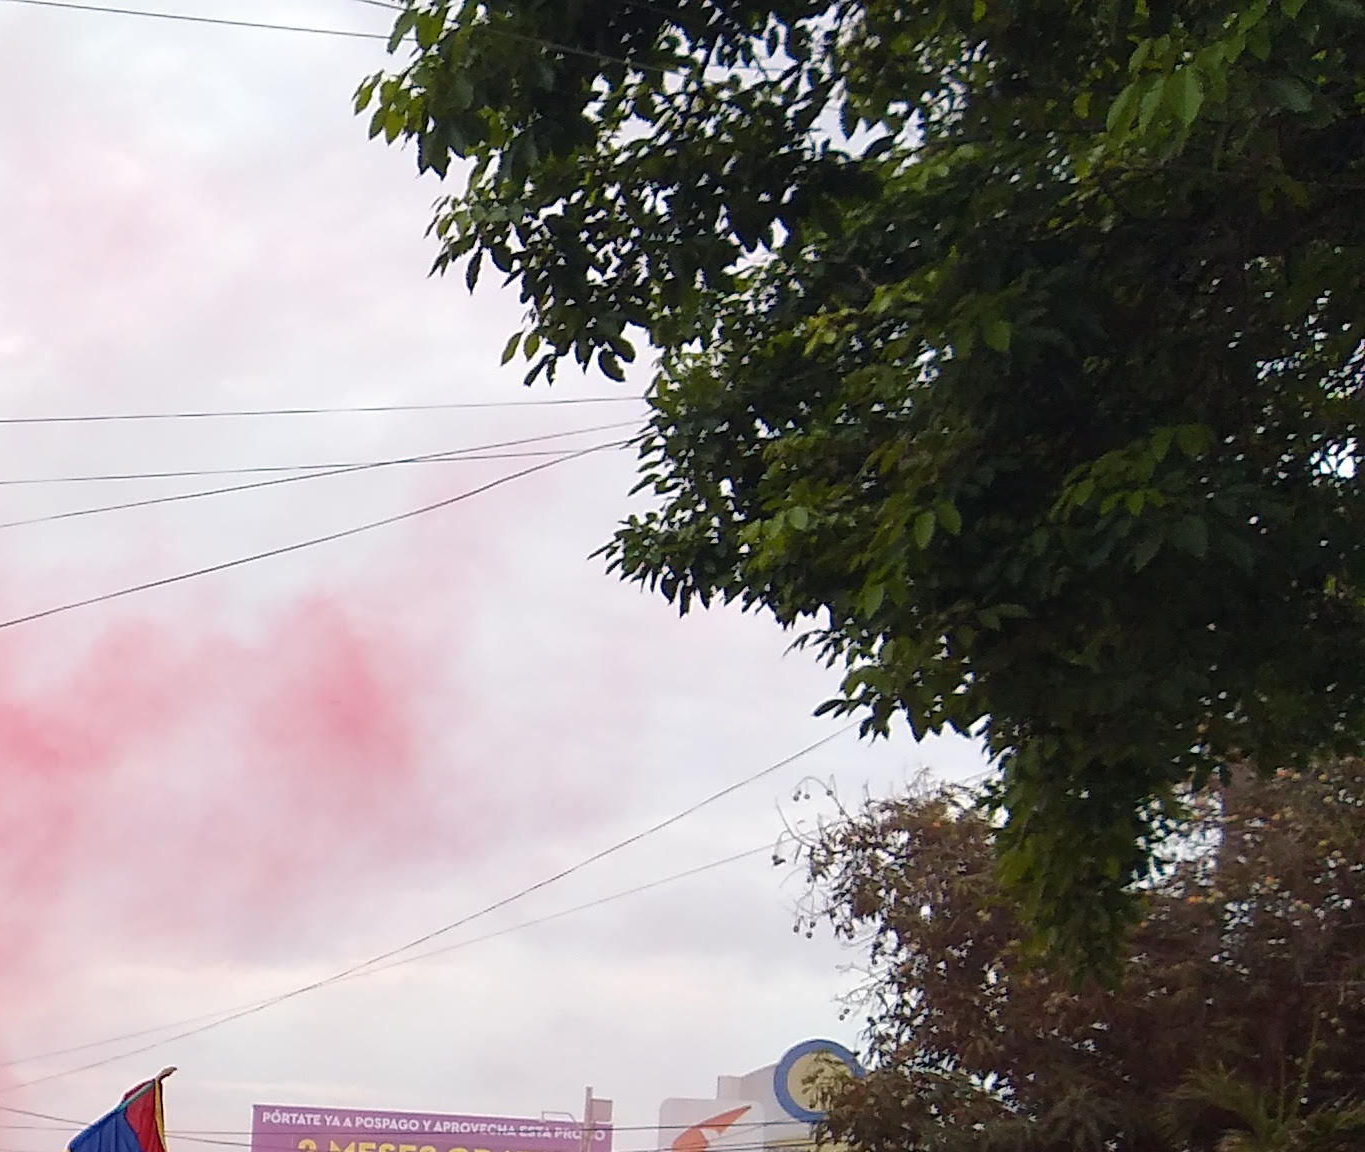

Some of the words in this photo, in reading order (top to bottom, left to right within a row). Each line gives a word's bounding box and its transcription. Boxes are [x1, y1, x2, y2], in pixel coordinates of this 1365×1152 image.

[262, 1109, 322, 1126] PÓRTATE
[324, 1114, 341, 1127] YA
[343, 1115, 352, 1128] A
[355, 1116, 420, 1131] POSPAGO
[422, 1119, 432, 1132] Y
[433, 1121, 518, 1137] APROVECHA
